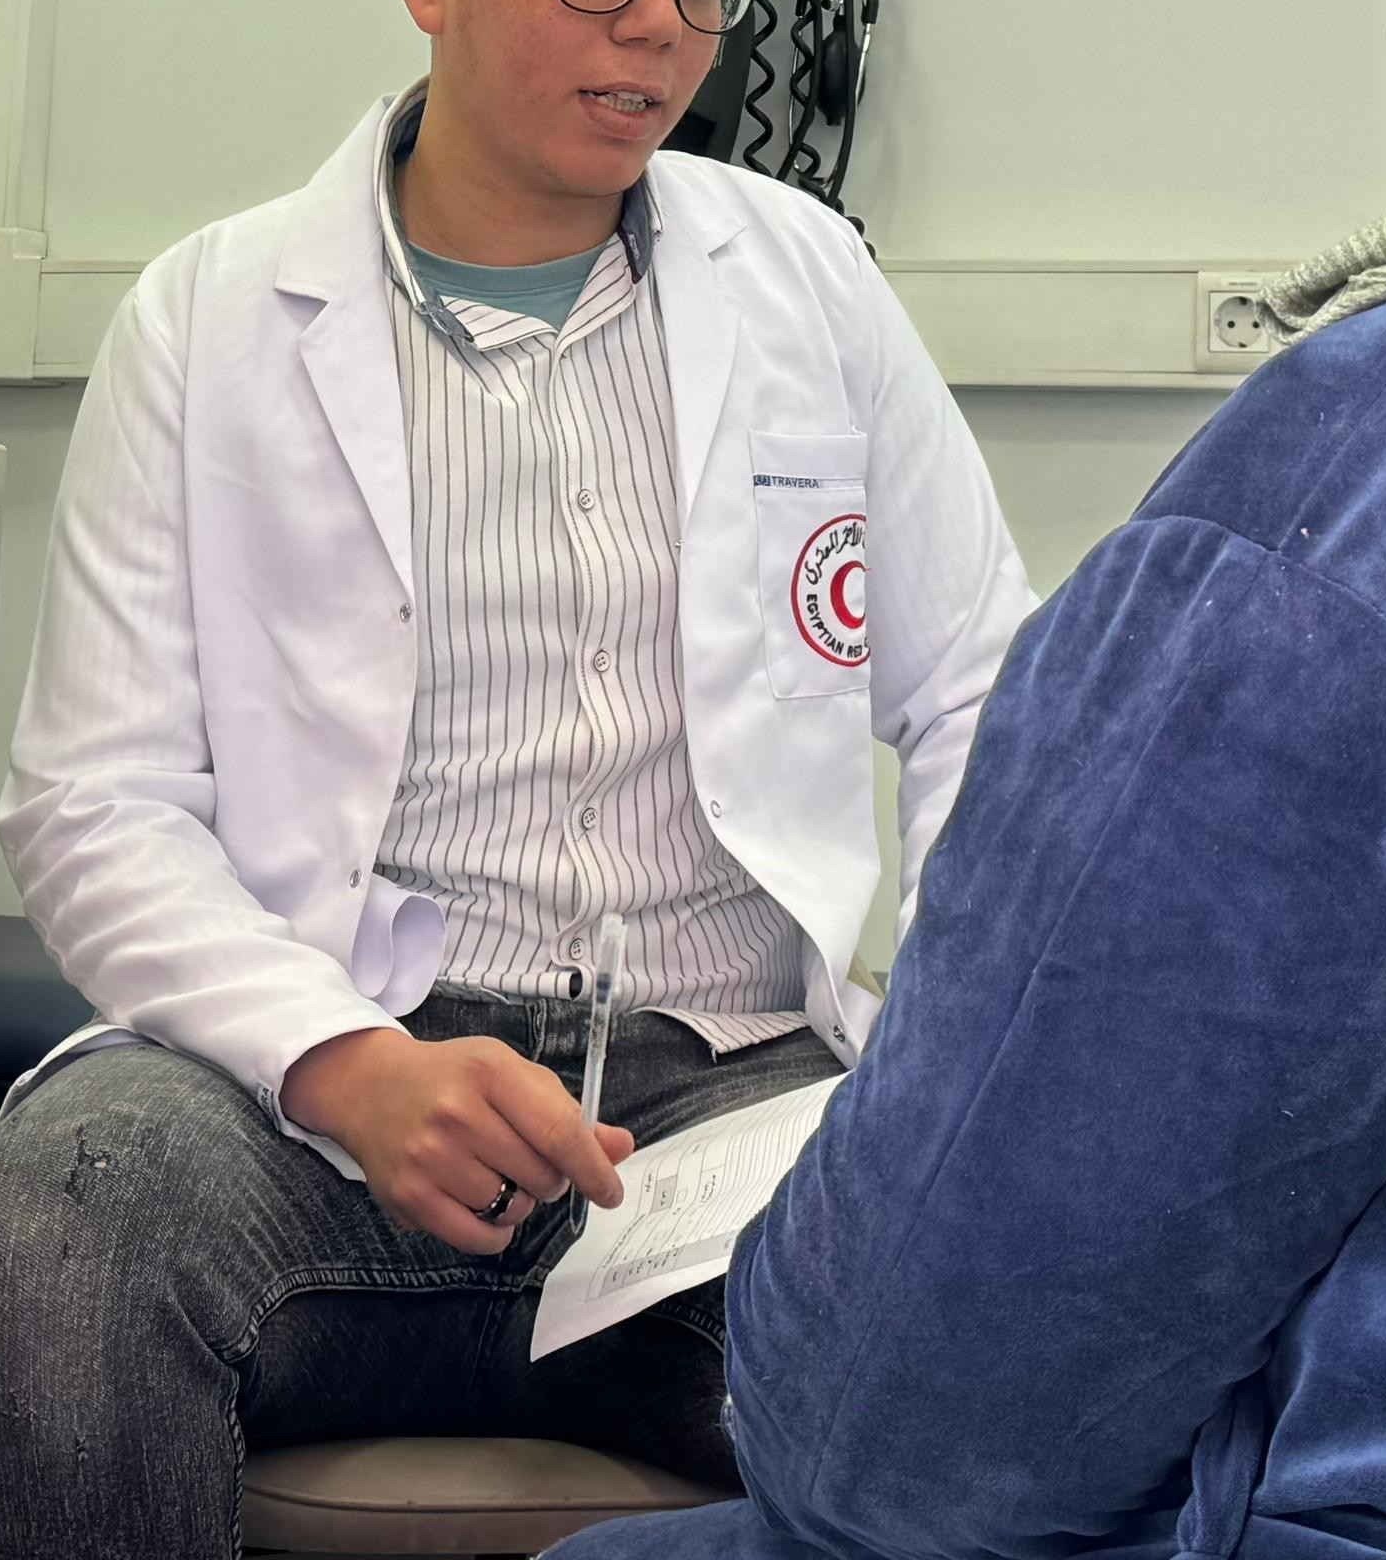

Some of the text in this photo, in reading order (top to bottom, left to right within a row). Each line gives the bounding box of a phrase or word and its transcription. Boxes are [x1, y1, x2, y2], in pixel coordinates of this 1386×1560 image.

[772, 476, 820, 488] TRAVERA
[806, 593, 863, 658] EGYPTIAN RED
